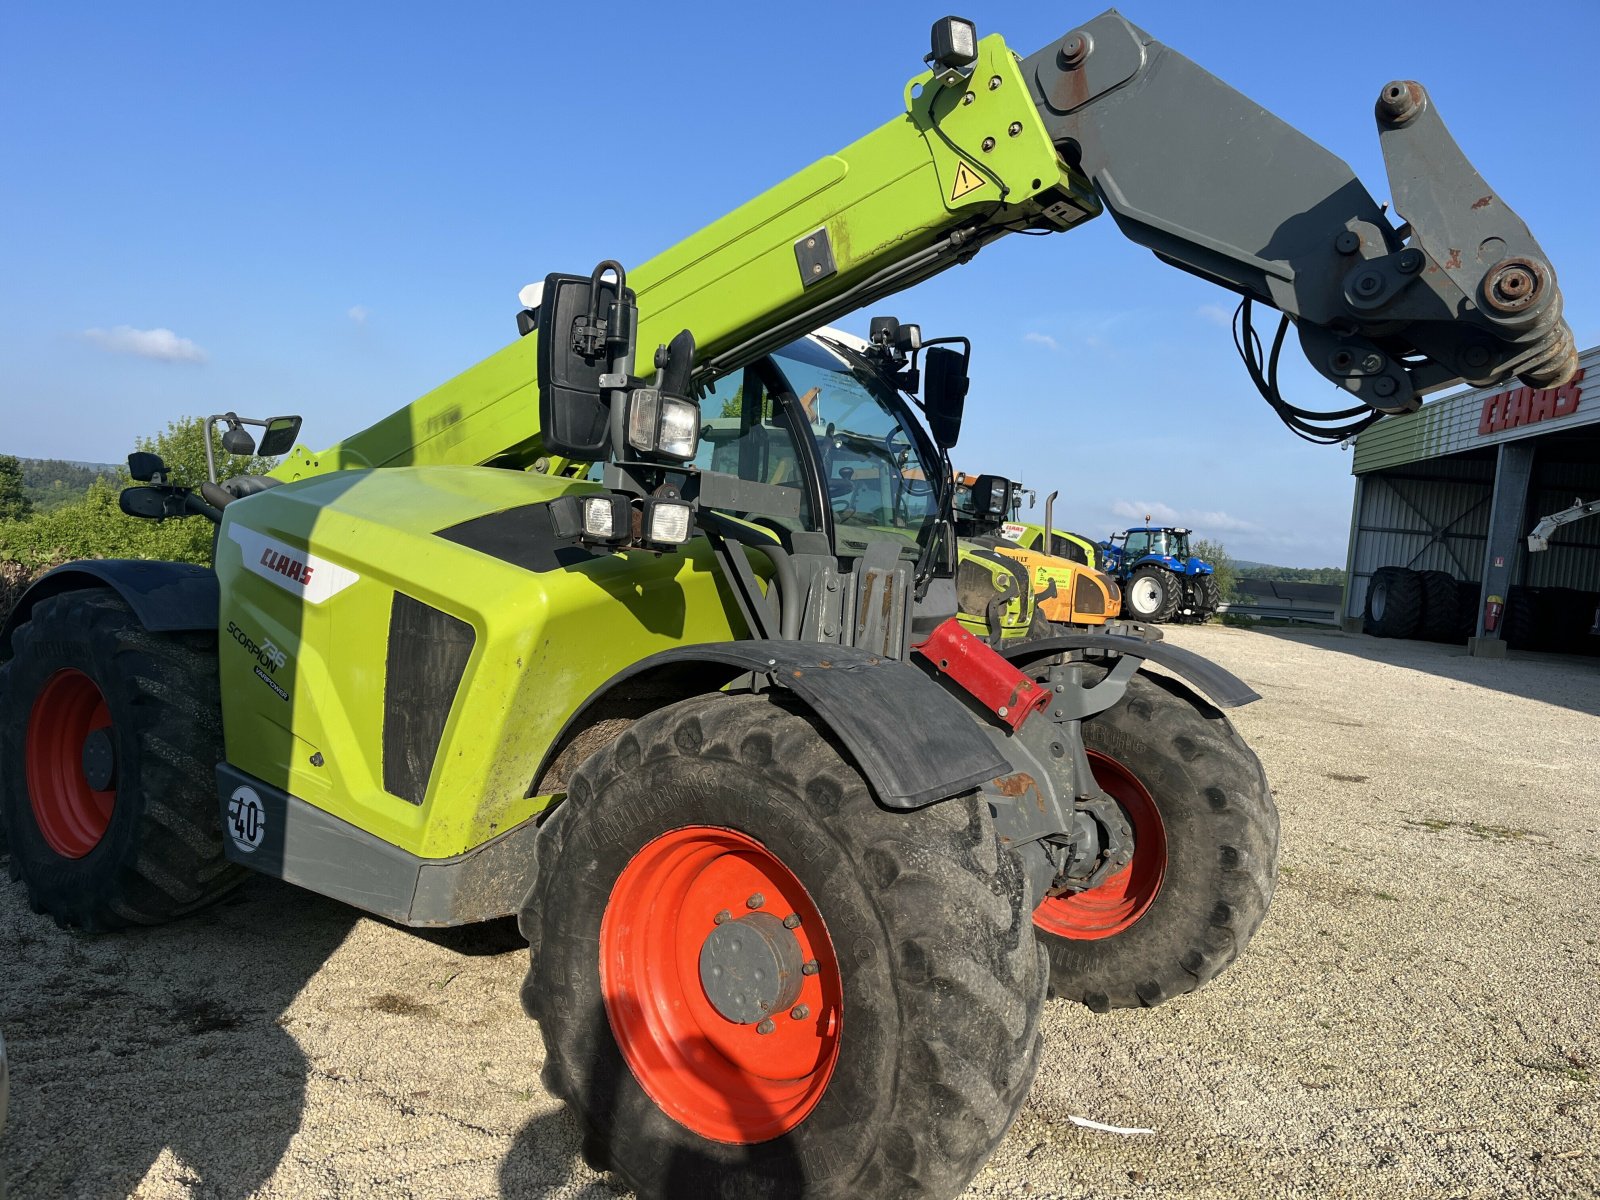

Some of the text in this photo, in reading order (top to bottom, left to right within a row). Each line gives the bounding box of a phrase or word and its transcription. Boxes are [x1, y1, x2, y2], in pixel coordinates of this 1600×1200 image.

[1478, 368, 1586, 436] CLAAS
[260, 548, 314, 586] CLAAS
[227, 621, 278, 675] SCORPION
[259, 636, 288, 669] 736
[254, 666, 289, 700] VARIPOWER
[231, 796, 258, 842] 40
[578, 766, 720, 850] TRELLEBORG
